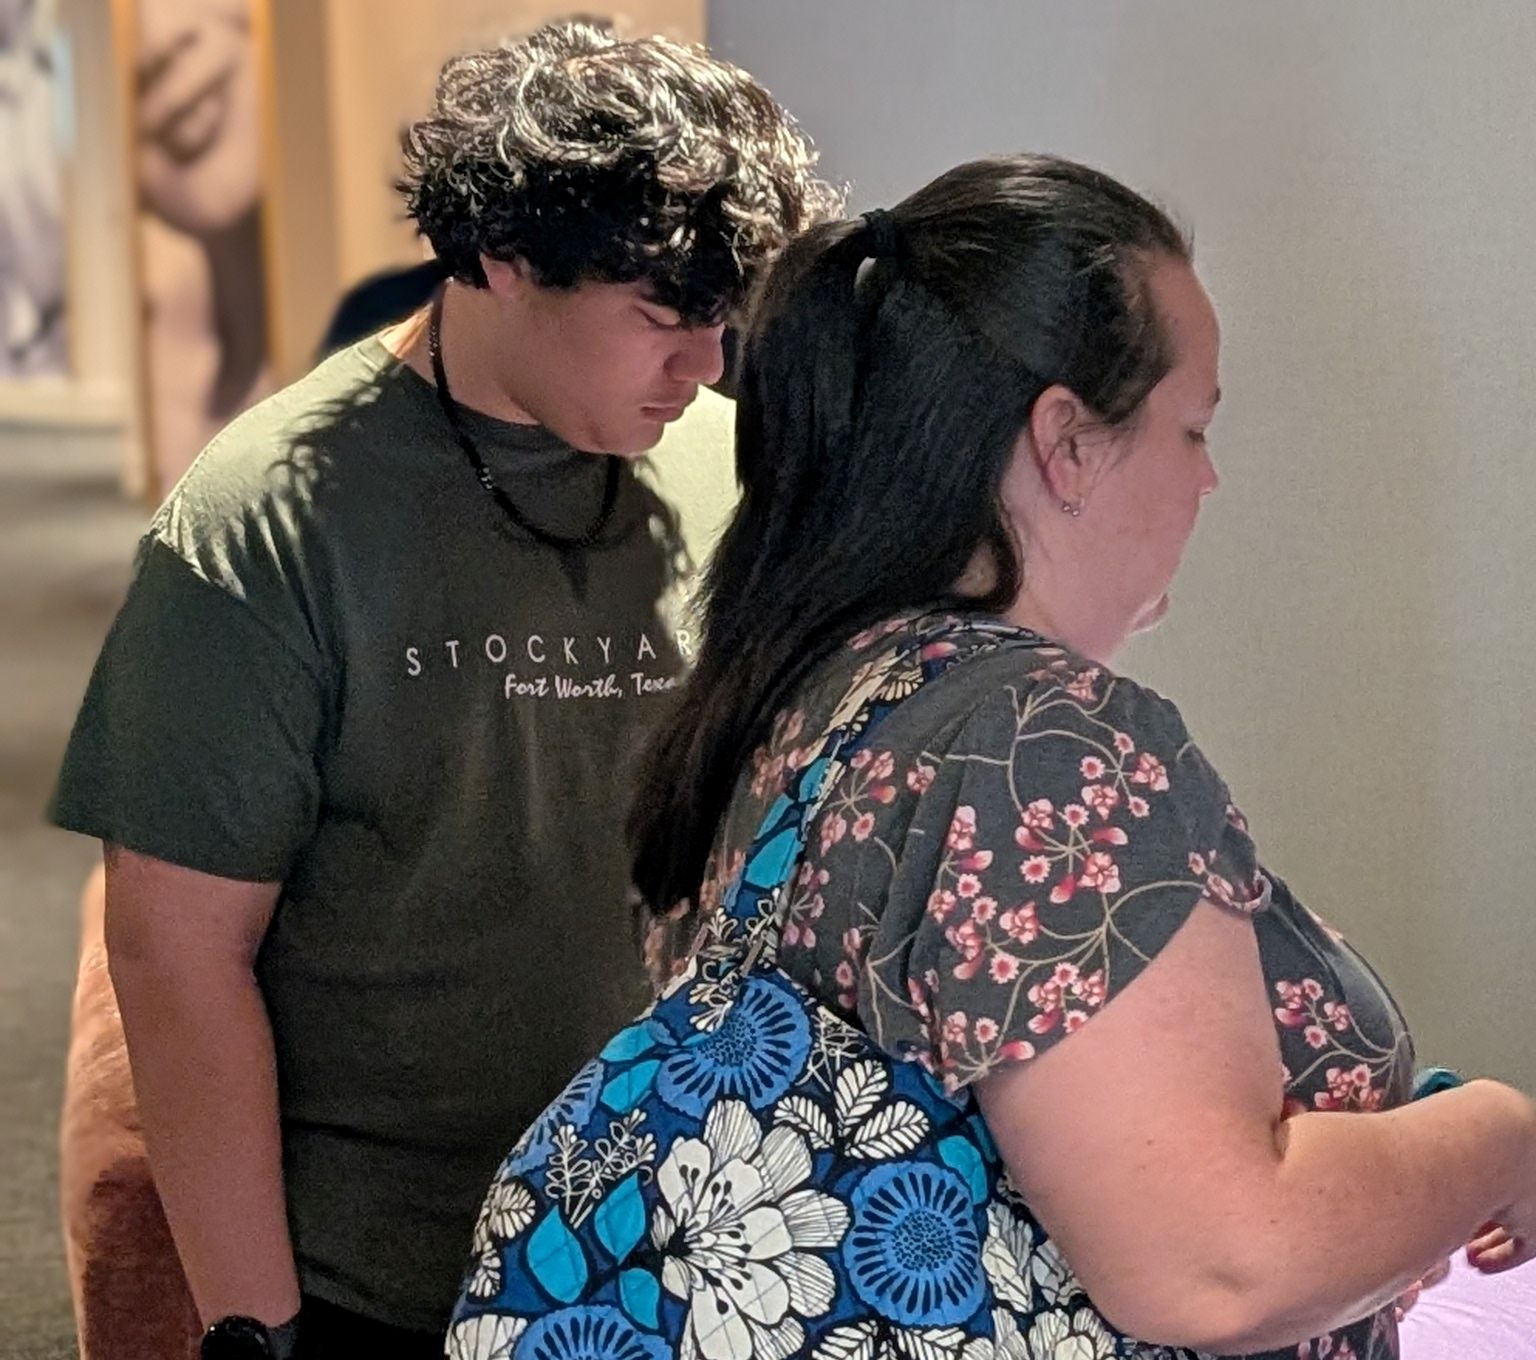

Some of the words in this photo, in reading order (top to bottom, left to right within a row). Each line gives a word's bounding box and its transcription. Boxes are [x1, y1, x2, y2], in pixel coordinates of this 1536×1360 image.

[405, 630, 693, 677] STOCKYAR
[504, 673, 550, 700] Fort
[554, 673, 623, 700] Worth,
[630, 671, 678, 695] Texa
